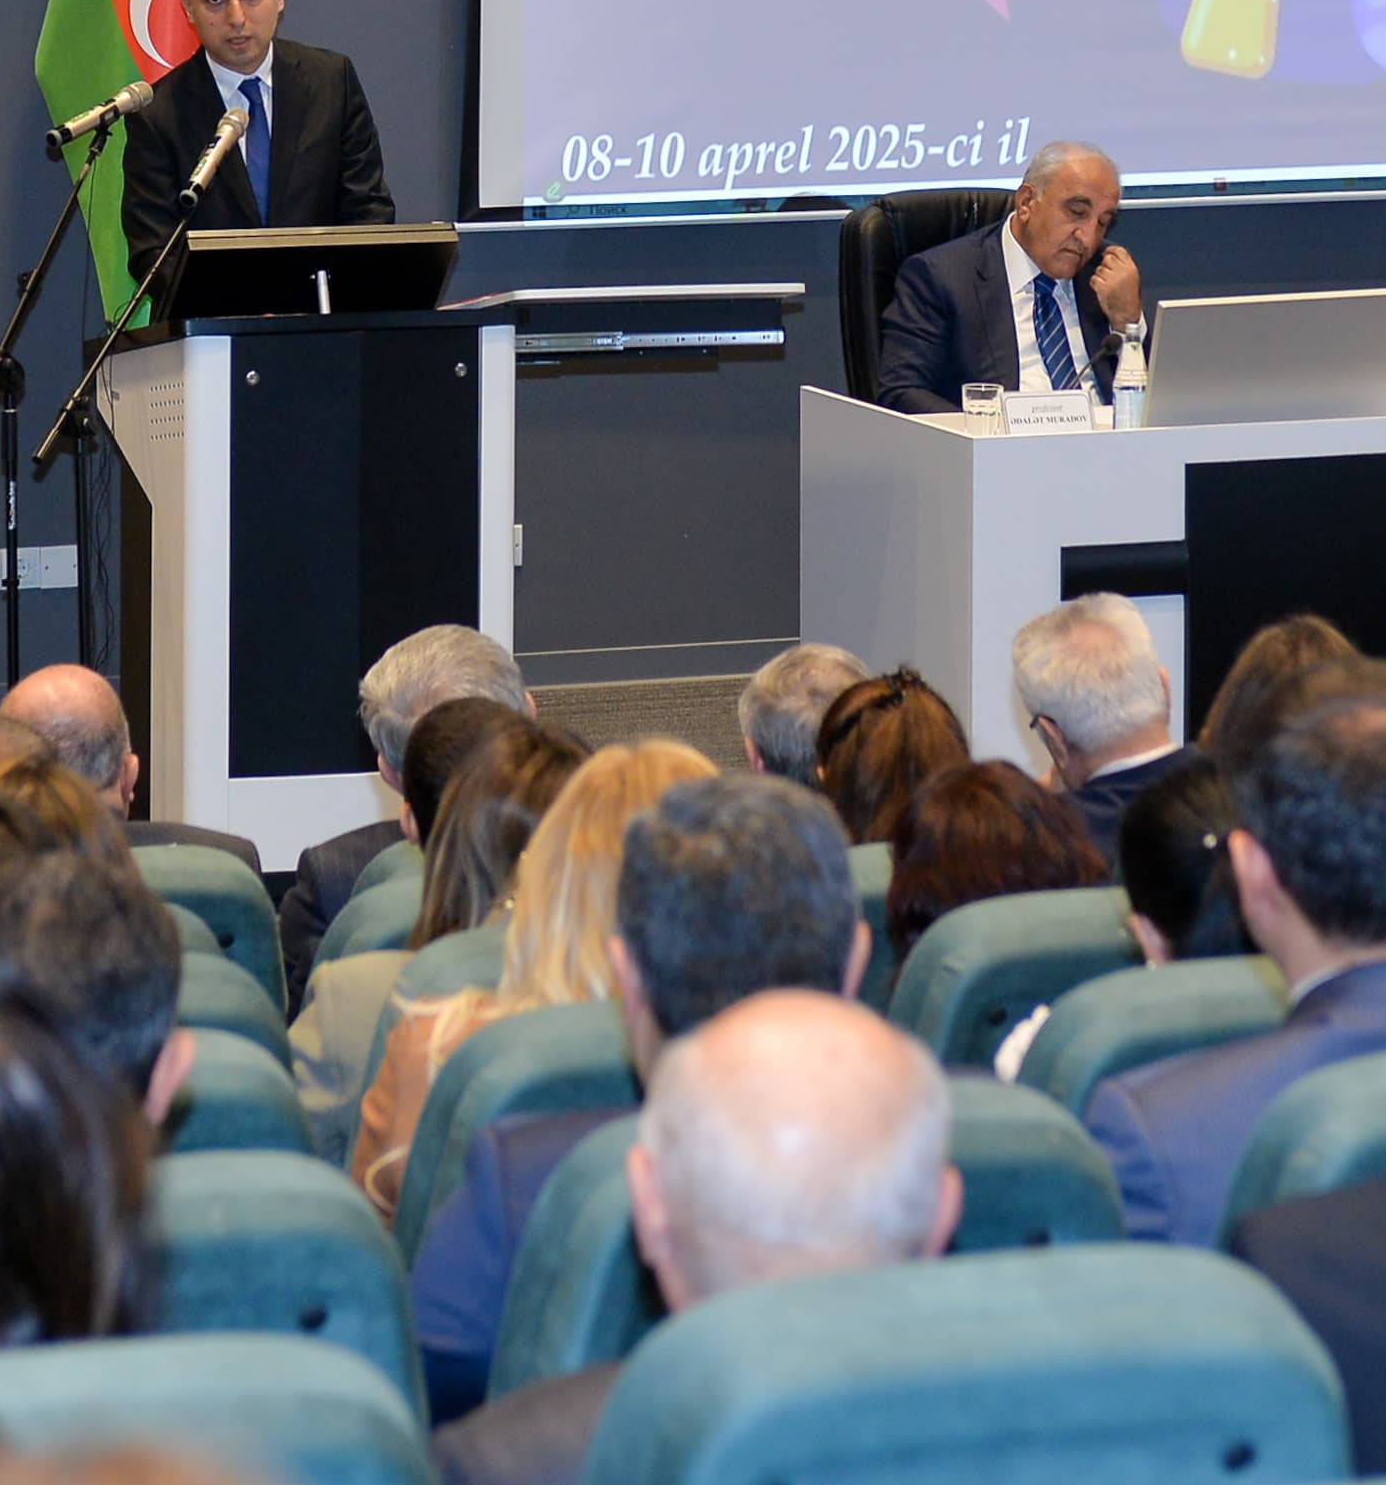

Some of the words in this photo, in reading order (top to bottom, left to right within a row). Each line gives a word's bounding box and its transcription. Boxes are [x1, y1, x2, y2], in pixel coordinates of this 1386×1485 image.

[560, 131, 686, 183] 08-10
[697, 123, 814, 191] aprel
[824, 119, 986, 172] 2025-ci
[996, 116, 1031, 166] il
